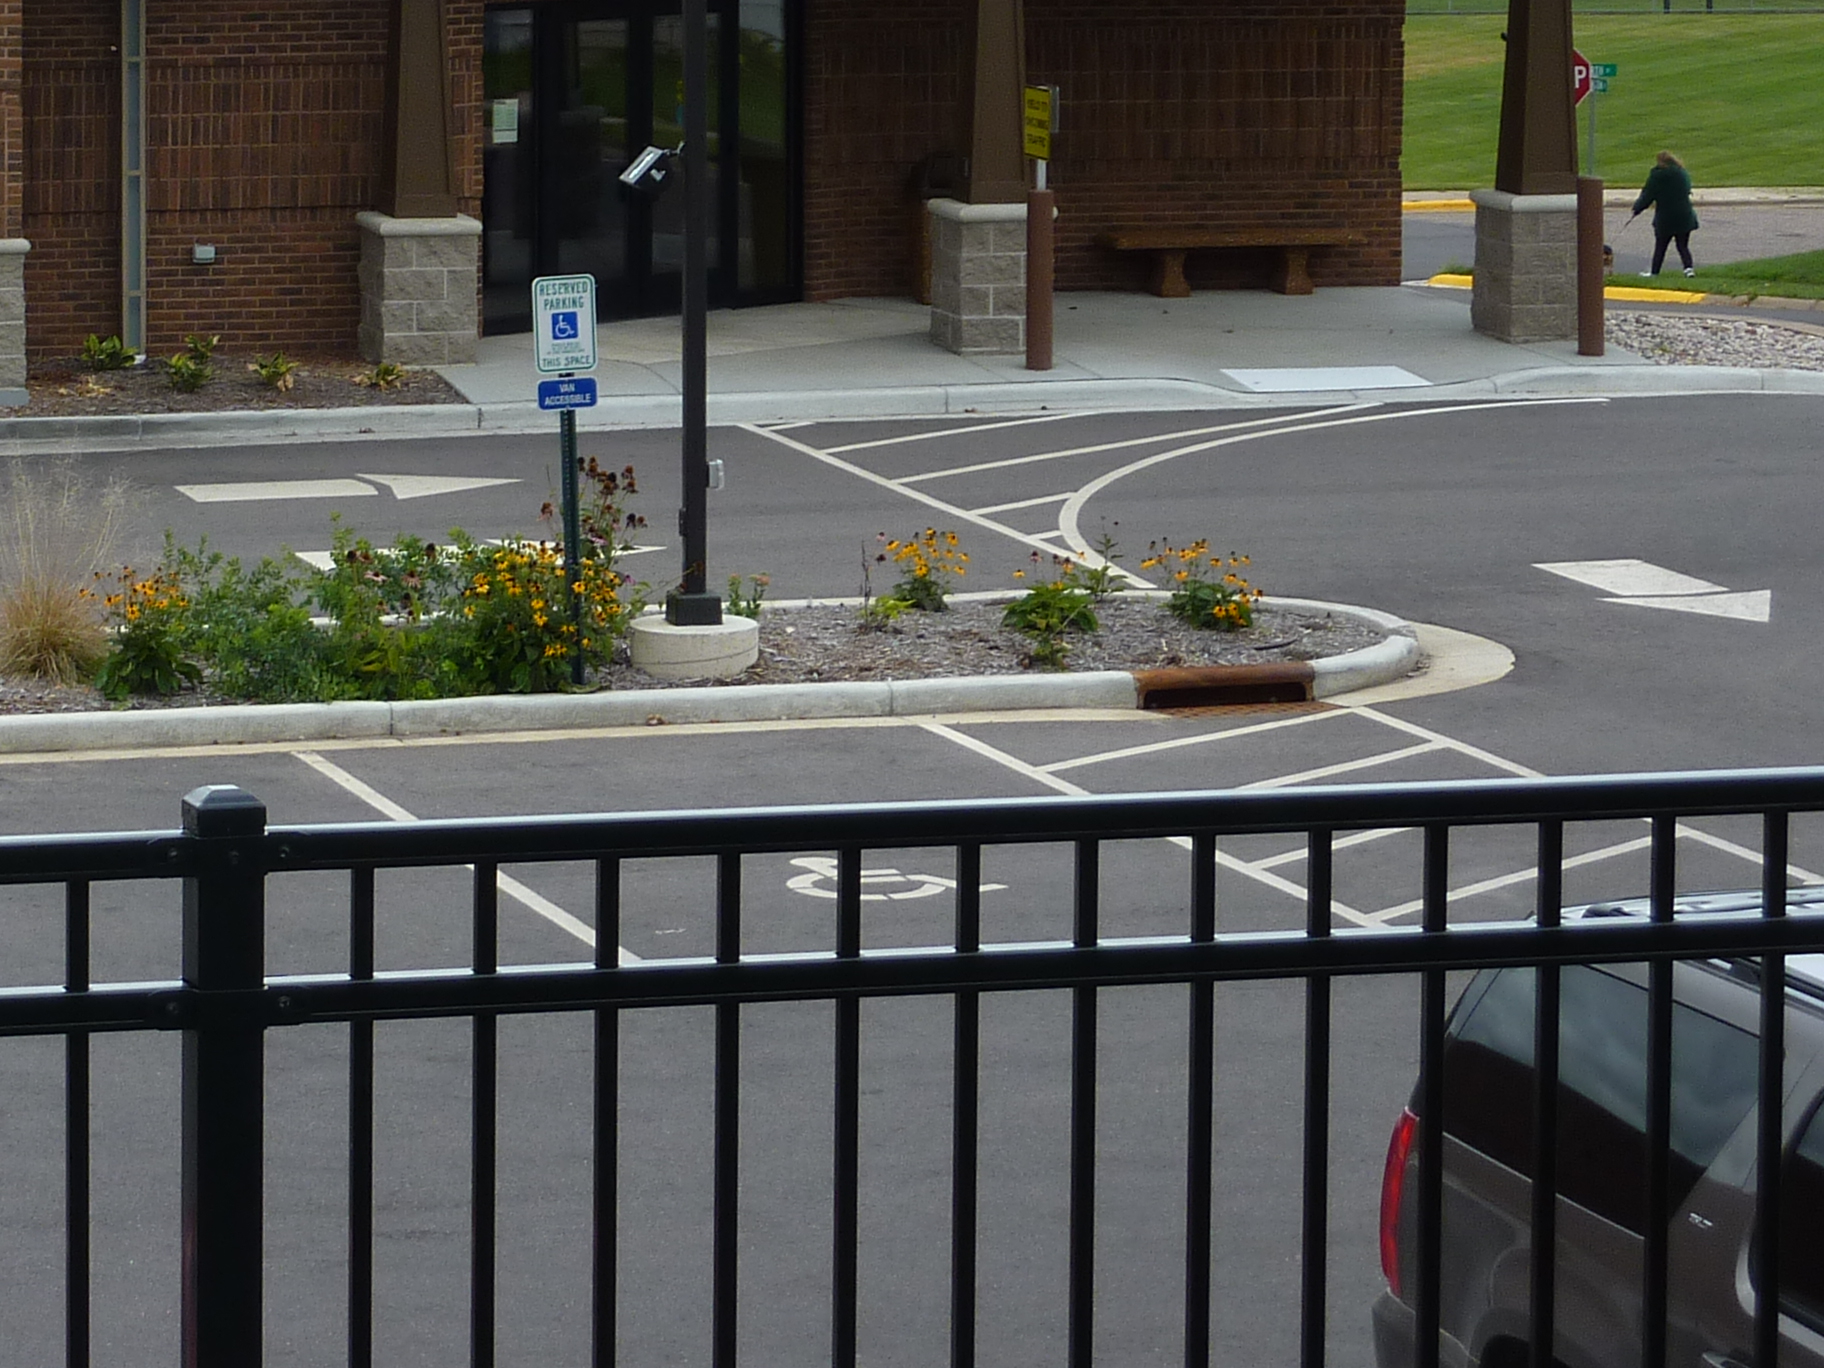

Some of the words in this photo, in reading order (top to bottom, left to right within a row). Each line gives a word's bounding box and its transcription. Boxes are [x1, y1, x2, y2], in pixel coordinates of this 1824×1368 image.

[539, 281, 588, 296] RESERVED
[544, 296, 584, 310] PARKING
[542, 357, 561, 367] THIS
[564, 355, 591, 366] SPACE
[559, 383, 575, 392] VAN
[545, 393, 592, 405] ACCESSIBLE
